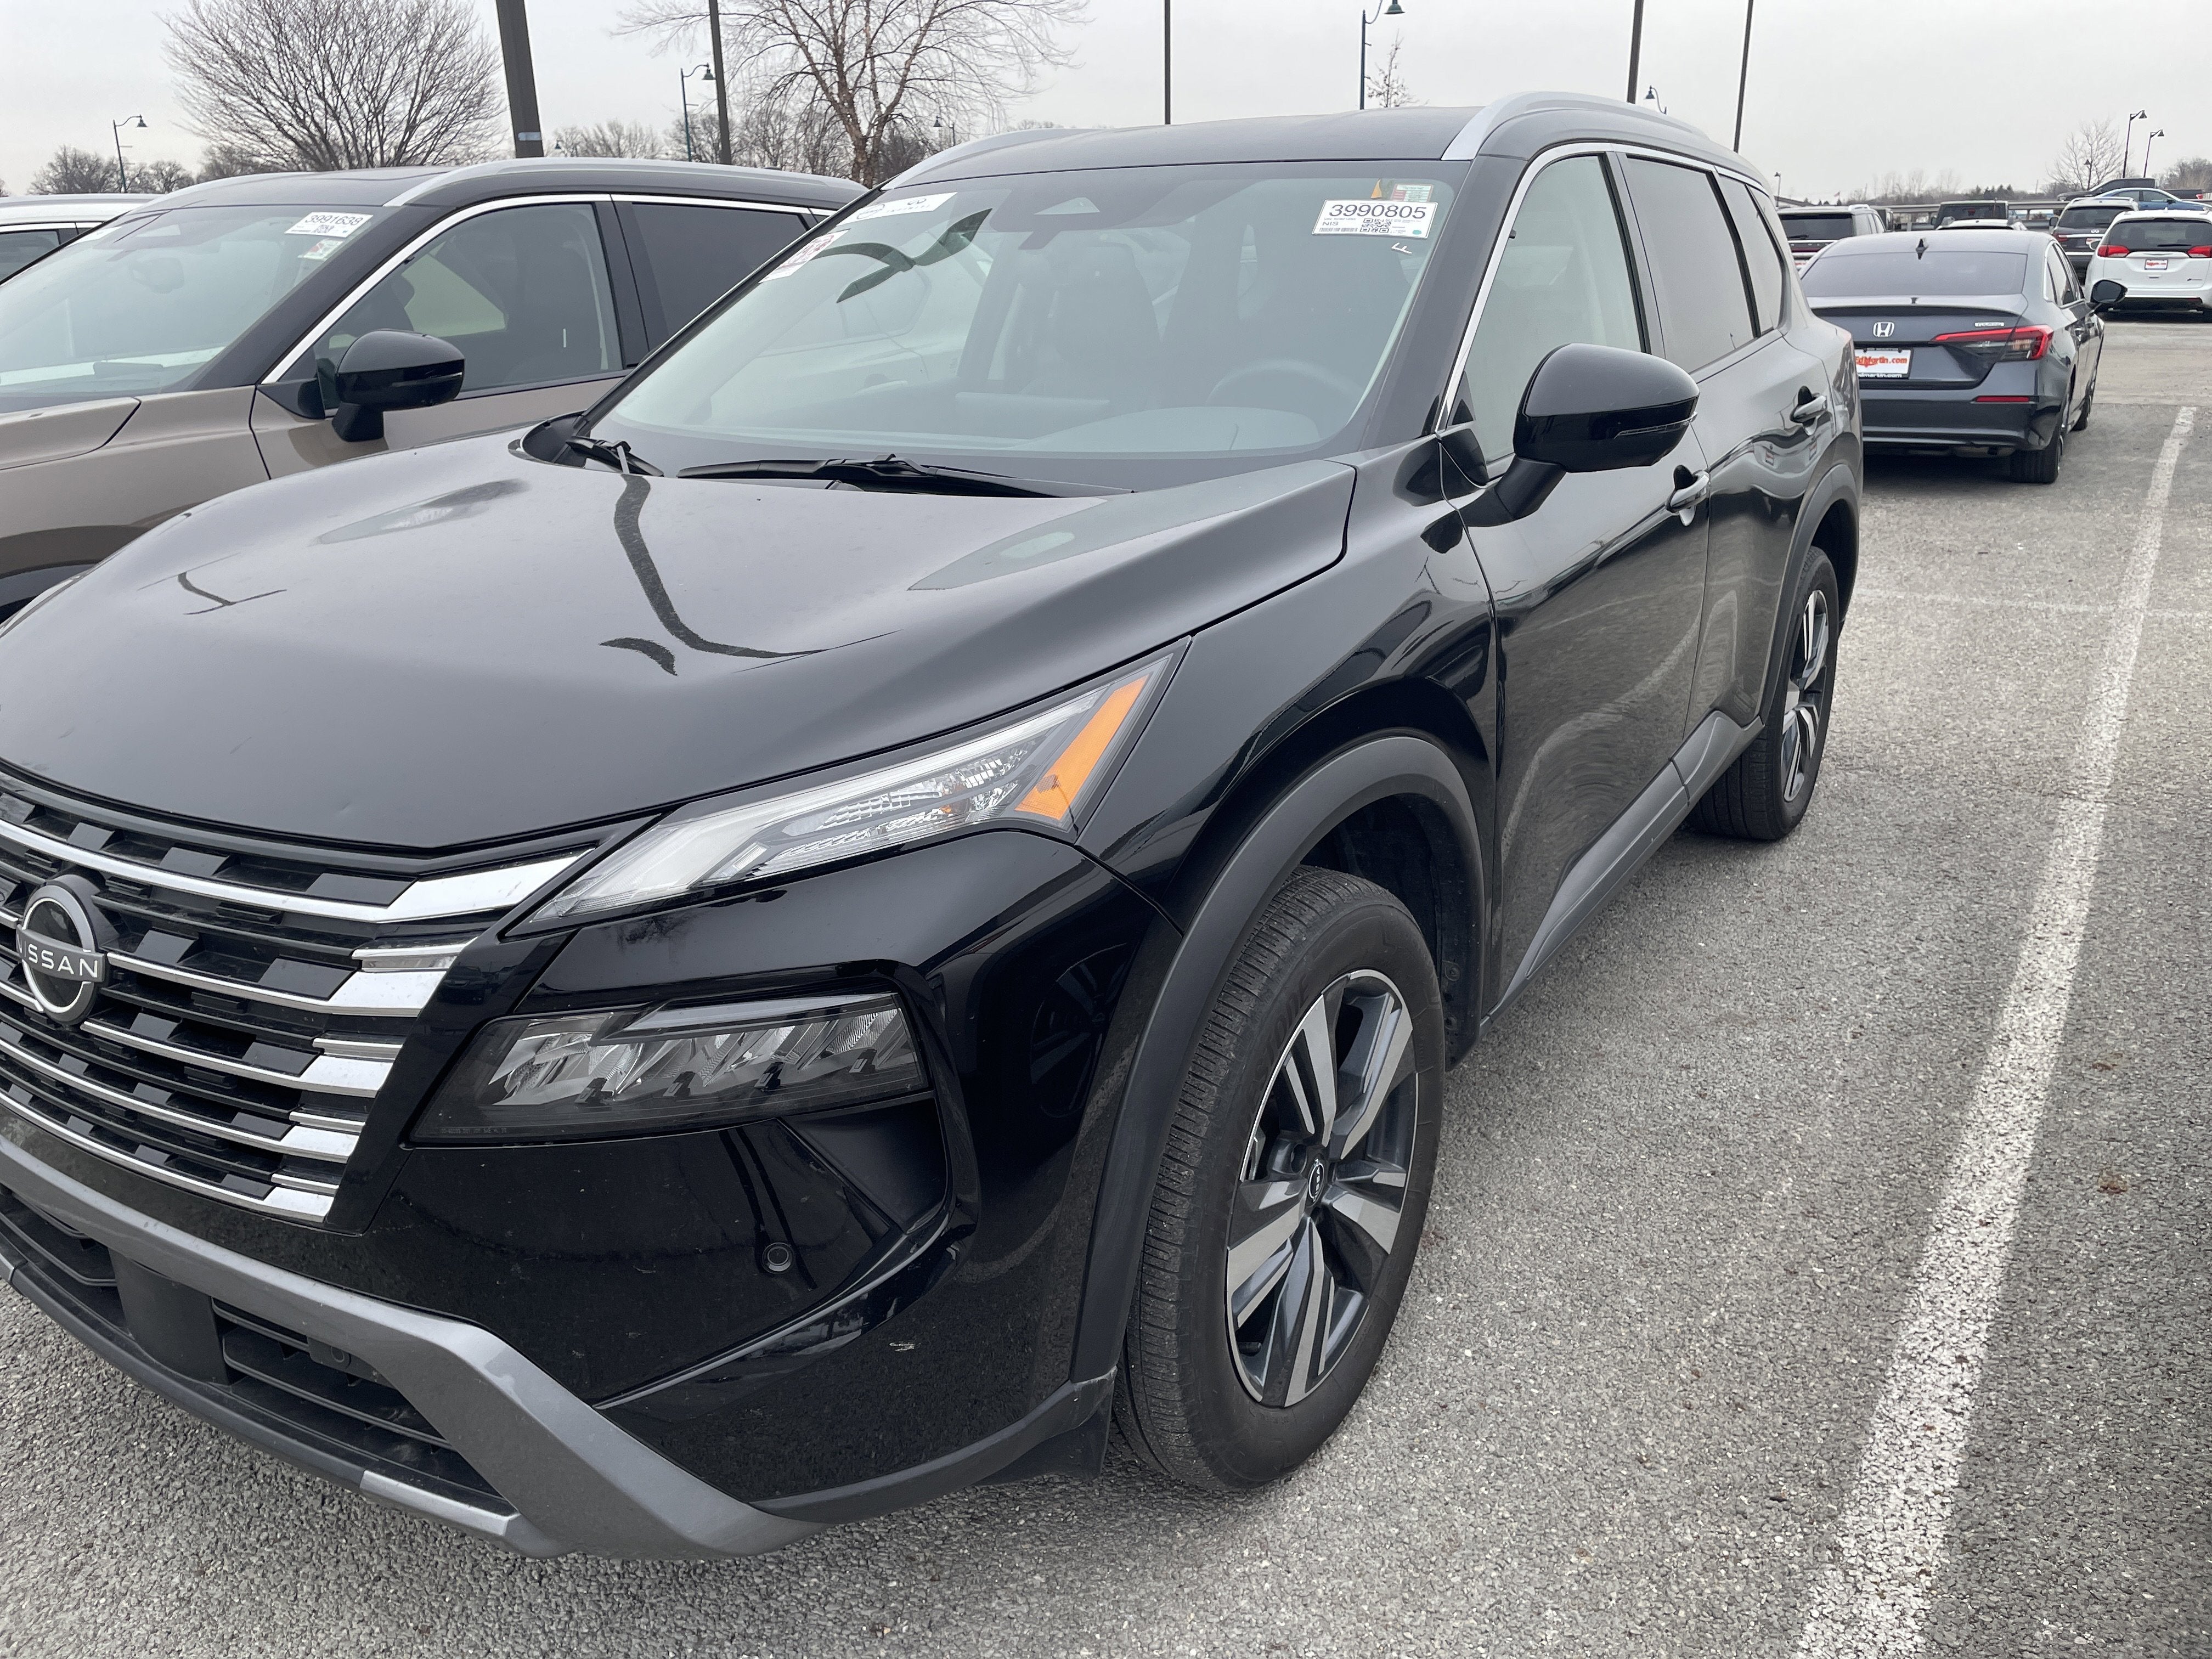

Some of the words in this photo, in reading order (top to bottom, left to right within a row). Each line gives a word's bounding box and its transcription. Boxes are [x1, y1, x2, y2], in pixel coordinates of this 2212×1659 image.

[1329, 204, 1427, 219] 3990805
[305, 215, 363, 225] 3991638
[16, 933, 98, 978] NISSAN
